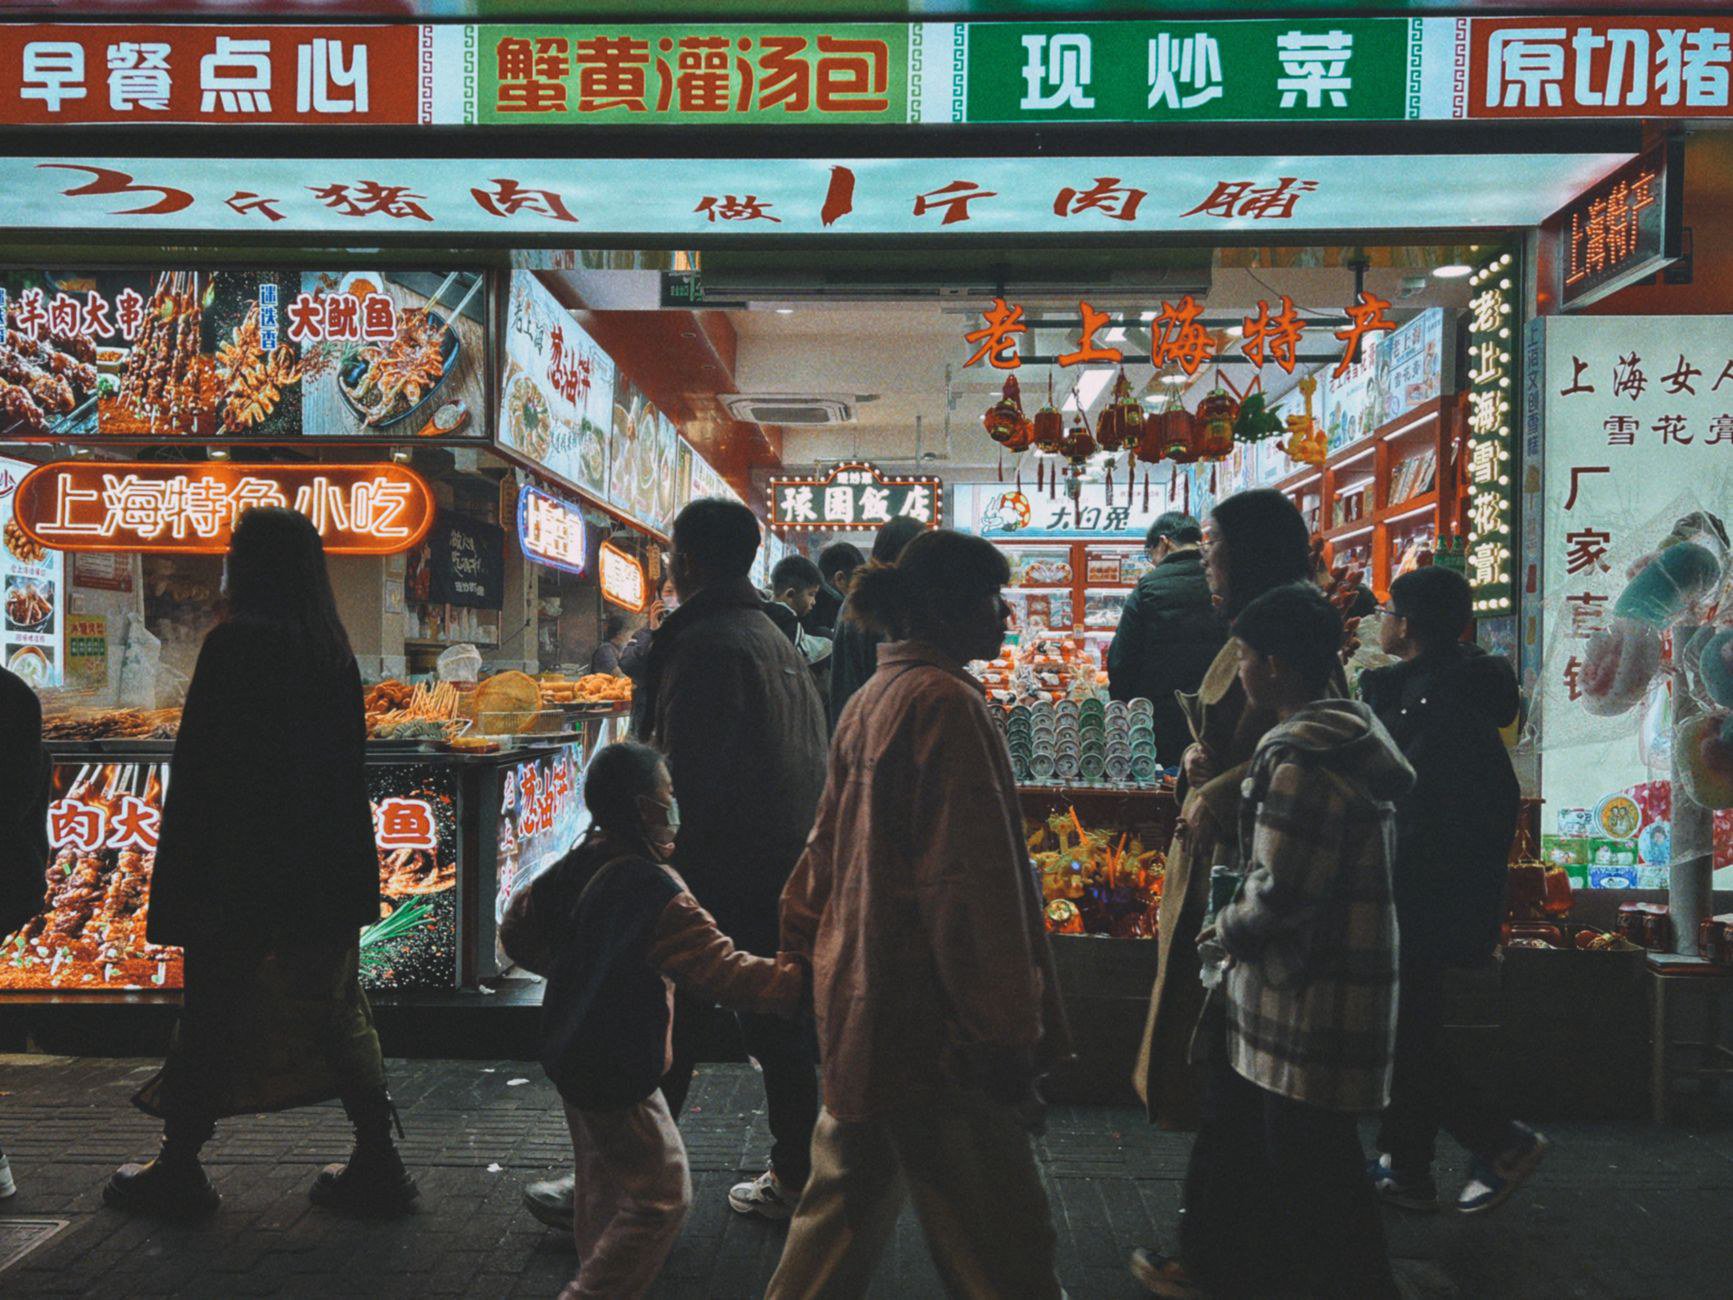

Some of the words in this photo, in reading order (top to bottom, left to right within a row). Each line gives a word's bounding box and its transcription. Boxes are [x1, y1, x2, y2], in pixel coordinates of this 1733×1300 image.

[20, 36, 369, 114] 早餐点心
[495, 34, 890, 113] 蟹黄灌汤包
[1020, 30, 1353, 110] 现炒菜
[1487, 27, 1732, 108] 原切猪
[17, 287, 145, 341] 羊肉大串
[259, 284, 279, 351] 迷迭香
[288, 294, 398, 342] 大鱿鱼
[963, 291, 1397, 378] 老上海特产
[1470, 290, 1502, 585] 老上海雪花膏
[1603, 413, 1733, 446] 雪花膏
[1046, 506, 1131, 531] 大白兔
